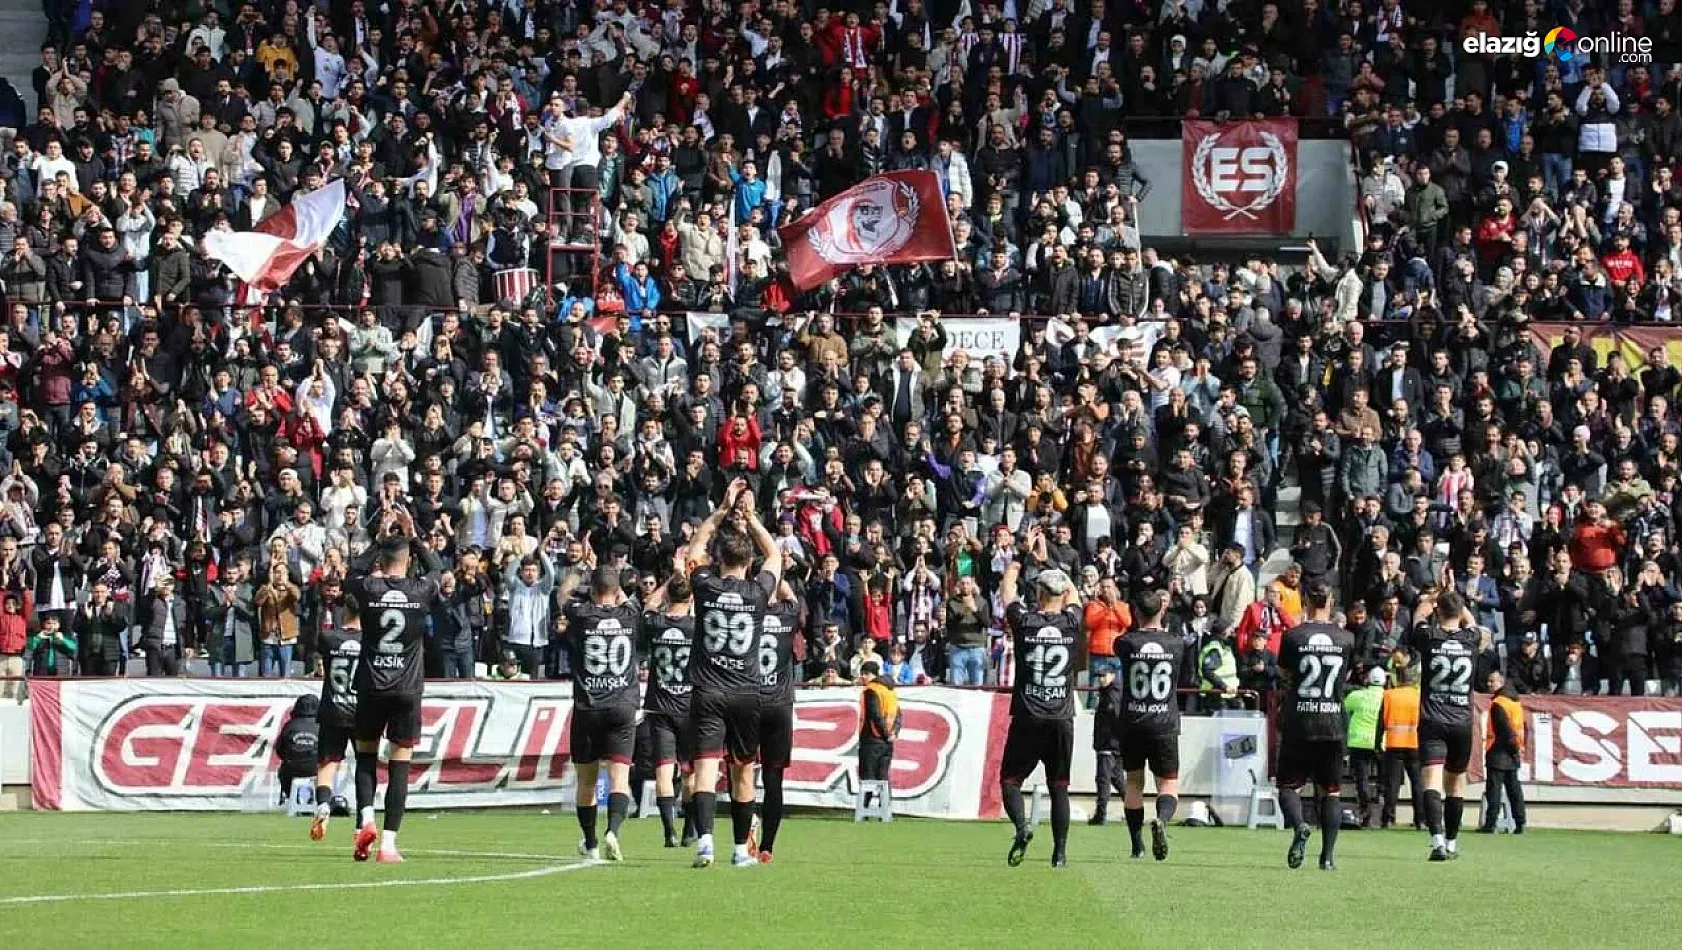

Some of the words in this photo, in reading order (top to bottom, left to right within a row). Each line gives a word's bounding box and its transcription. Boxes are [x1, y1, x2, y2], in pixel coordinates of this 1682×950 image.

[1211, 147, 1273, 191] ES
[379, 608, 406, 654] 2
[702, 610, 753, 655] 99
[585, 635, 632, 676] 80
[1025, 645, 1069, 686] 12
[1298, 654, 1343, 698] 27
[1430, 656, 1472, 693] 22
[1130, 661, 1173, 700] 66
